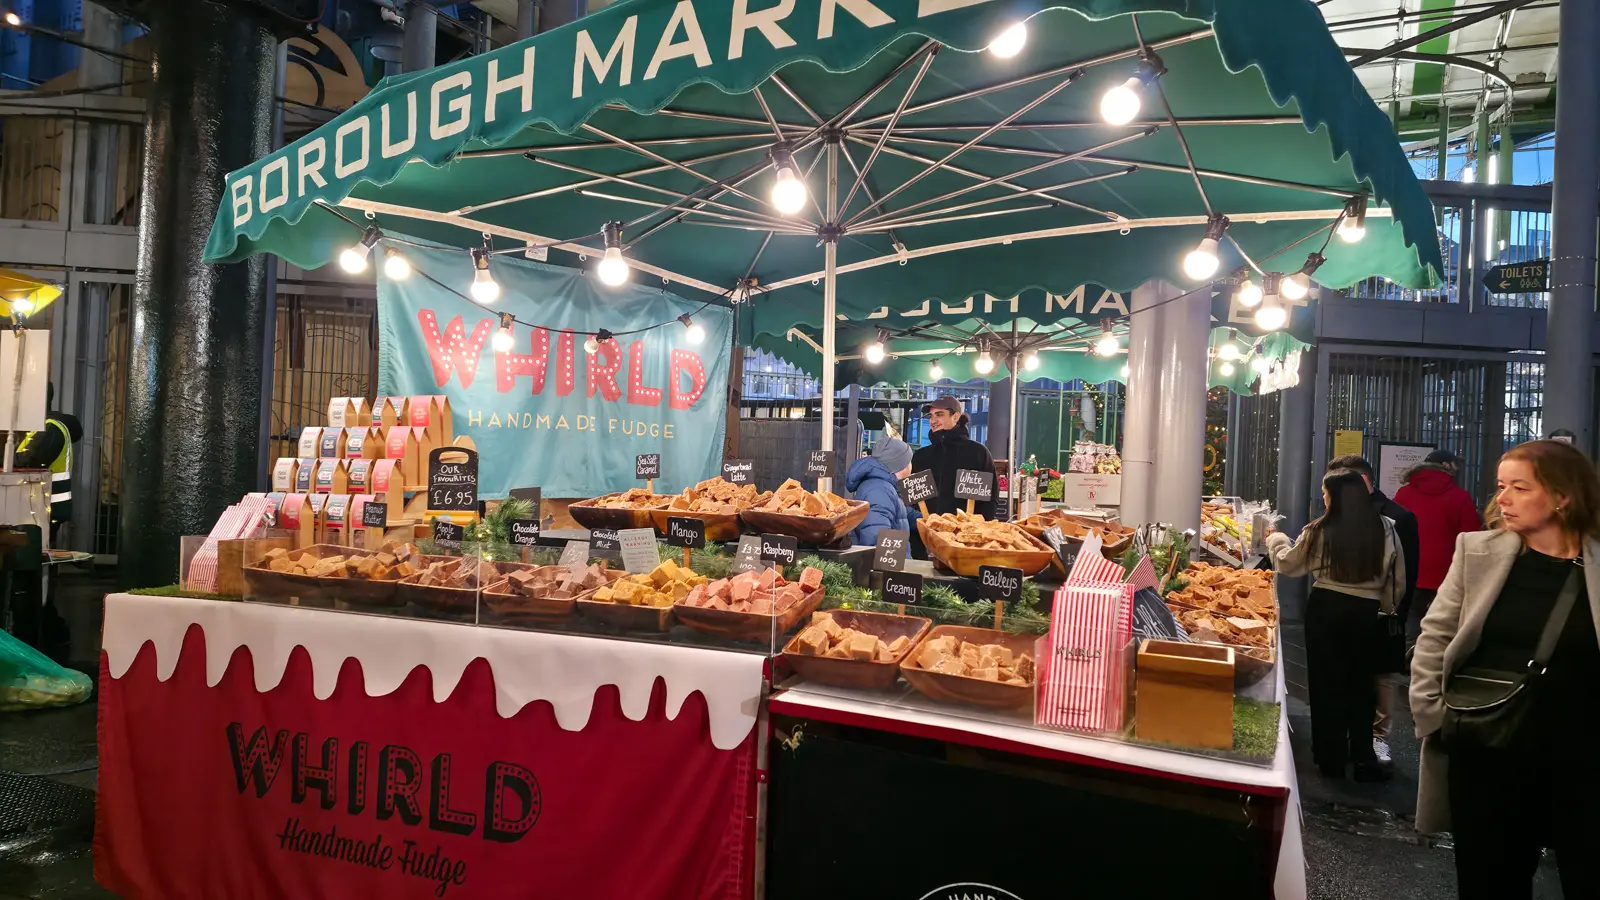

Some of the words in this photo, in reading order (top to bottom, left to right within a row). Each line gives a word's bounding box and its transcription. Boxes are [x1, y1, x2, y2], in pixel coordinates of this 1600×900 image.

[230, 45, 536, 229] BOROUGH
[572, 0, 975, 99] MARK
[1500, 265, 1543, 279] TOILETS
[417, 308, 707, 411] WHIRLD
[468, 409, 597, 433] HANDMADE
[608, 419, 675, 439] FUDGE
[637, 455, 647, 465] Sea
[647, 454, 657, 464] Salt
[811, 452, 826, 462] Hot
[440, 464, 460, 474] OUR
[637, 465, 658, 475] Caramel
[724, 463, 752, 474] Gingerbread
[808, 462, 828, 476] Honey
[433, 474, 476, 483] FAVOURITES
[731, 472, 746, 482] Latte
[903, 474, 928, 489] Flavour
[960, 471, 983, 484] White
[908, 486, 914, 494] of
[915, 483, 928, 491] the
[908, 485, 934, 502] Month!
[957, 483, 992, 497] Chocolate
[366, 504, 384, 514] Peanut
[365, 513, 382, 524] Butter
[436, 522, 455, 536] Apple
[512, 522, 540, 534] Chocolate
[671, 522, 698, 545] Mango
[514, 534, 536, 547] Orange
[592, 530, 620, 542] Chocolate
[596, 540, 612, 550] Mint
[763, 542, 794, 562] Raspberry
[880, 556, 898, 568] 100g
[886, 578, 916, 602] Creamy
[982, 570, 1018, 598] Baileys
[225, 722, 543, 844] WHIRLD
[276, 816, 394, 870] Handmade
[398, 839, 467, 898] Fudge
